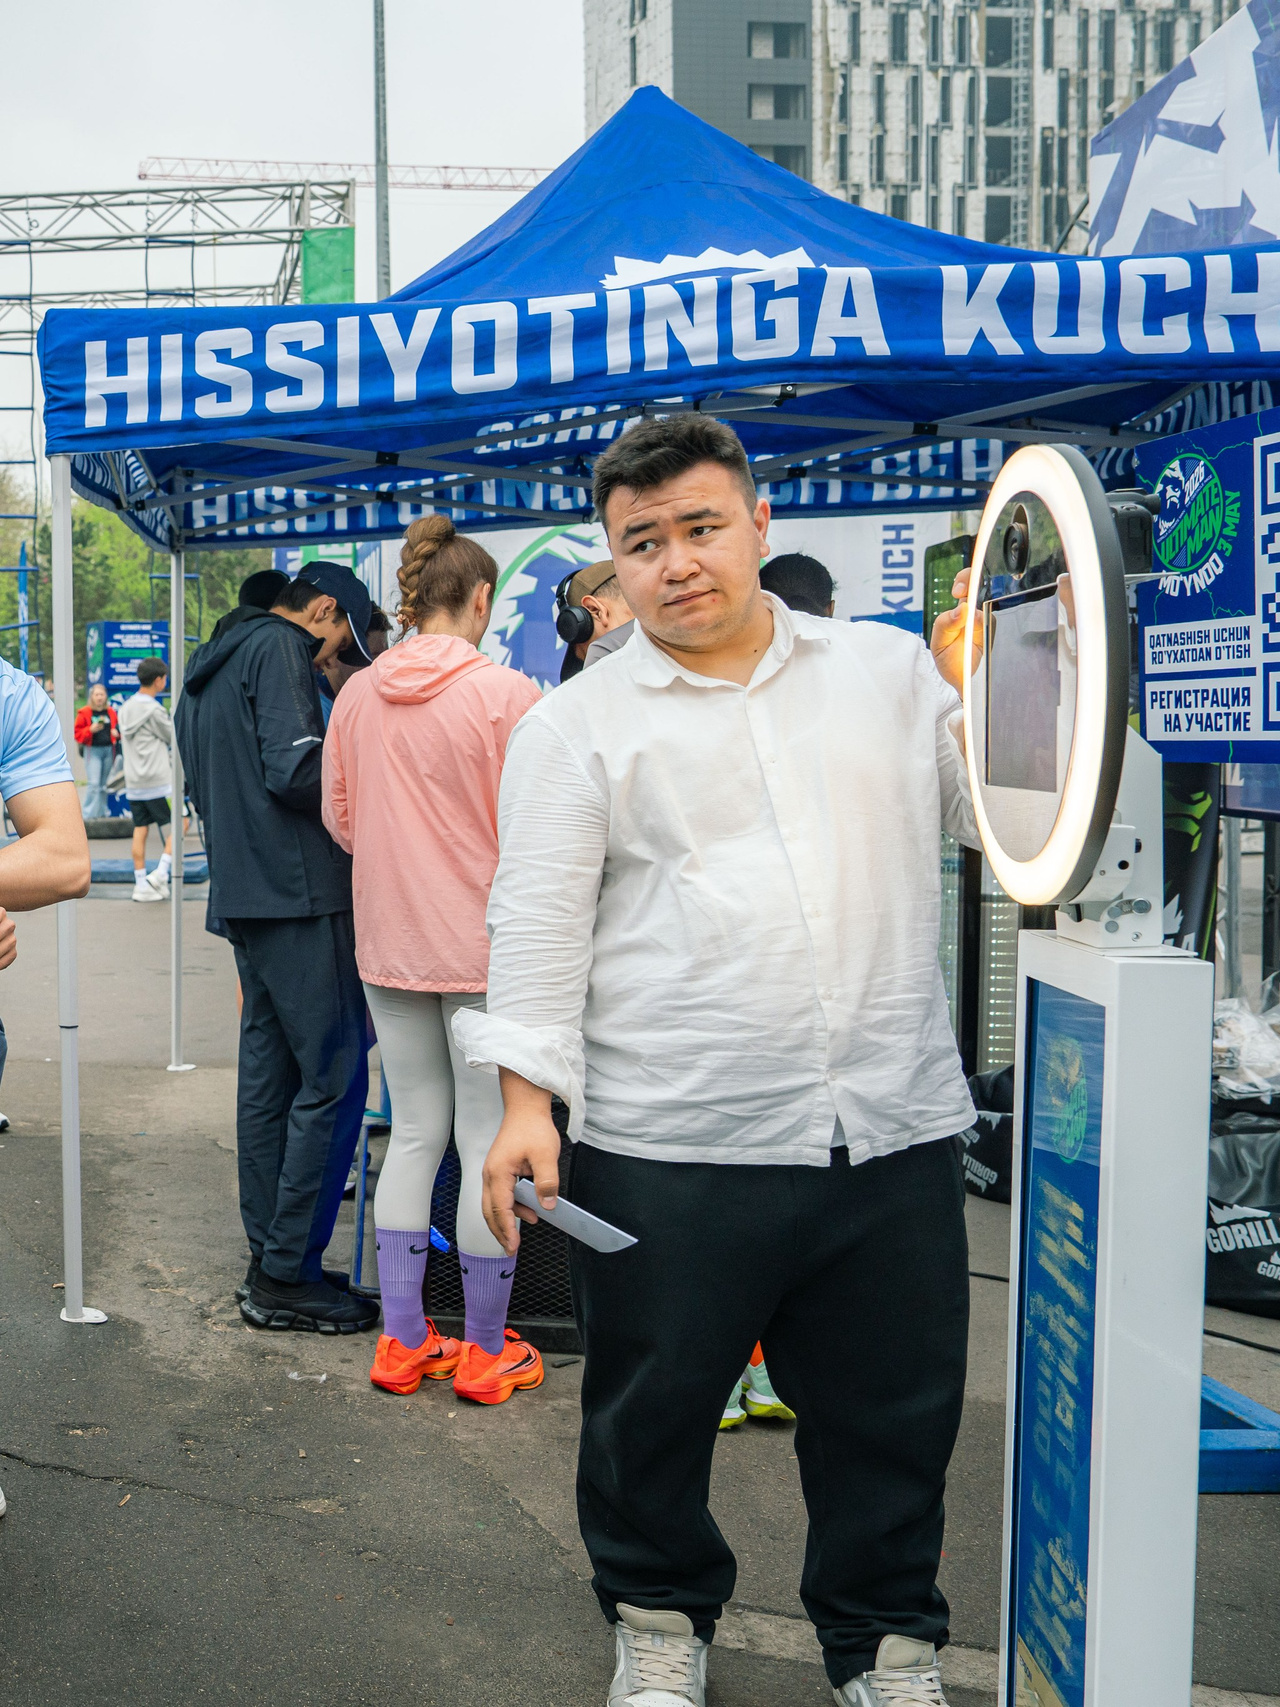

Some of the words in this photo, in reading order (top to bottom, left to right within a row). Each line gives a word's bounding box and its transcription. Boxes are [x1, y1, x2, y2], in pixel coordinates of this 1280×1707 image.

[85, 267, 891, 428] HISSIYOTINGA
[939, 252, 1280, 356] KUCH
[1184, 460, 1205, 505] 2026
[1161, 481, 1220, 563] ULTIMATE
[1222, 490, 1241, 537] MAY
[1187, 505, 1221, 566] MAN
[1216, 537, 1233, 557] 3
[1149, 629, 1211, 650] QATNASHISH
[1214, 625, 1251, 643] UCHUN
[1151, 647, 1212, 665] RO'YXATDAN
[1215, 644, 1251, 661] O'TISH
[1150, 687, 1251, 710] РЕГИСТРАЦИЯ
[1164, 713, 1182, 732] НА
[1185, 712, 1251, 732] УЧАСТИЕ
[962, 1152, 998, 1185] GORILLA
[1206, 1219, 1280, 1253] GORILL
